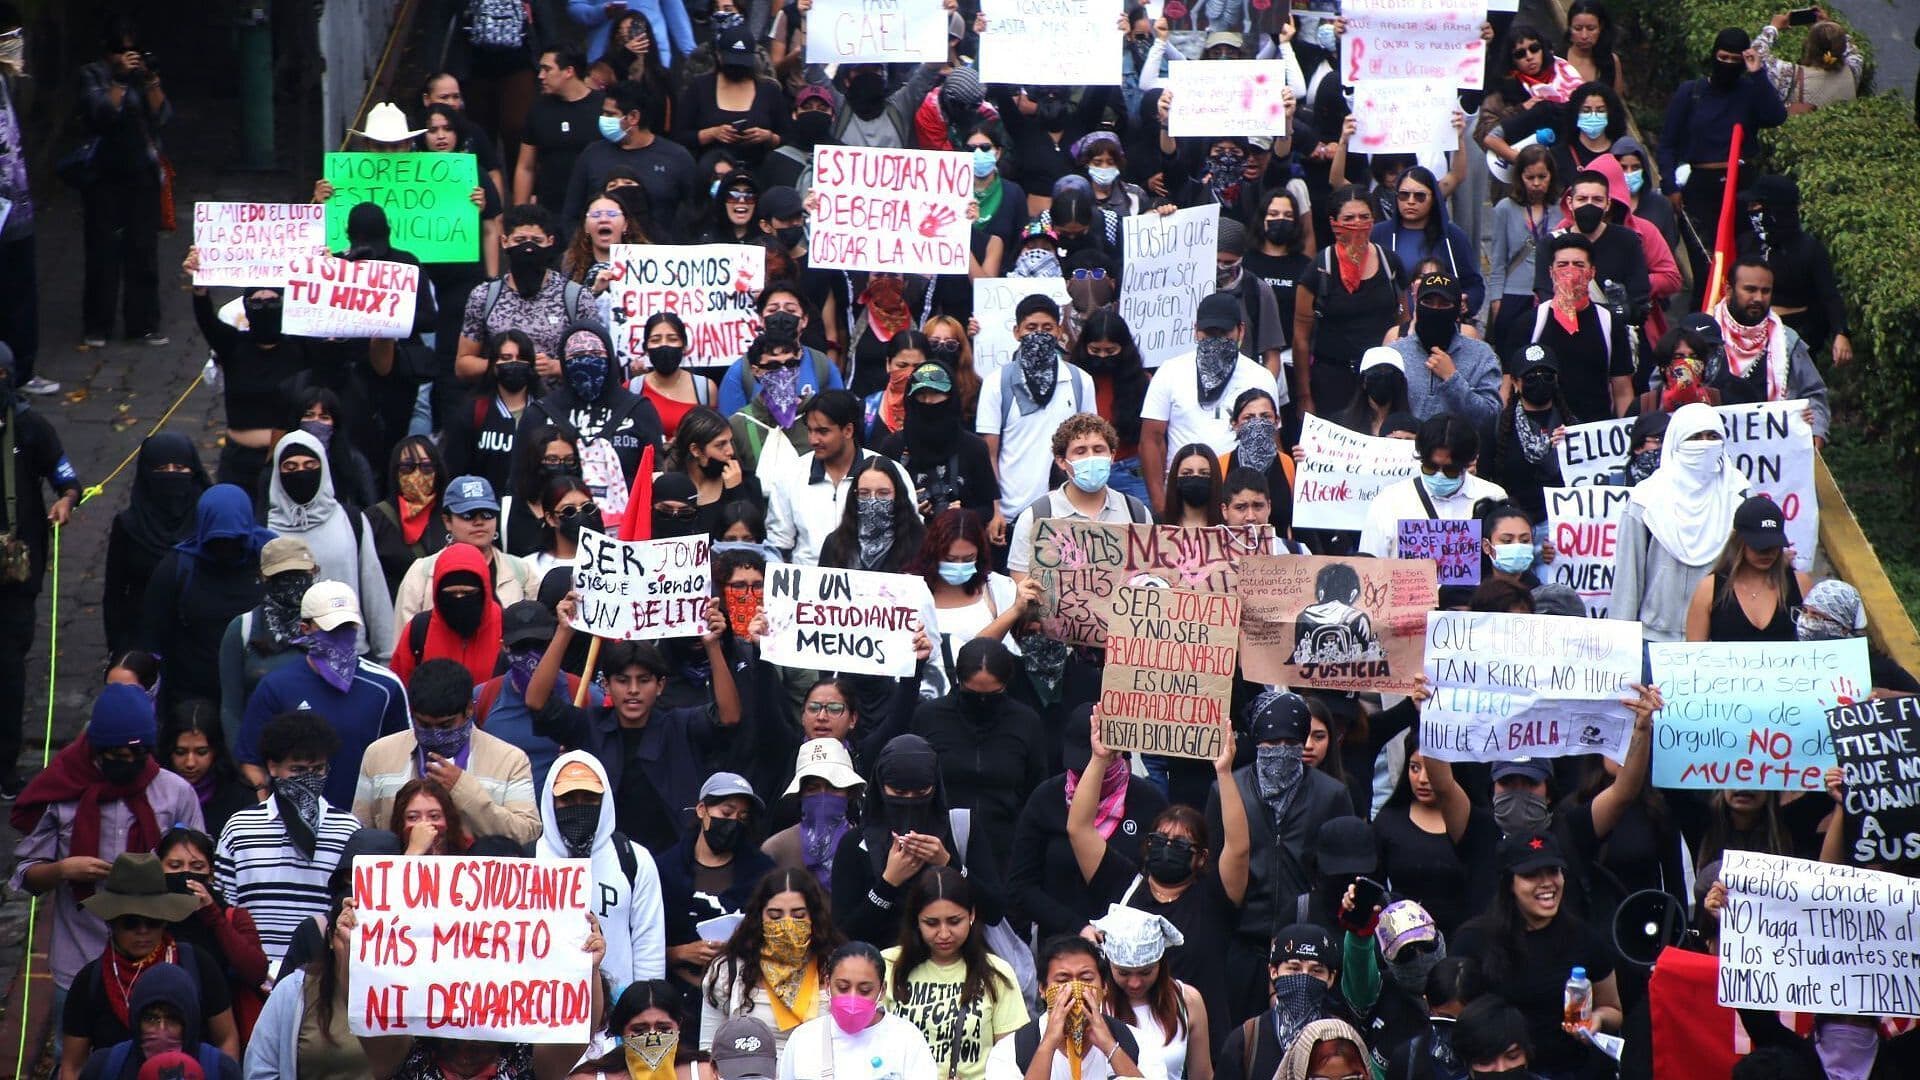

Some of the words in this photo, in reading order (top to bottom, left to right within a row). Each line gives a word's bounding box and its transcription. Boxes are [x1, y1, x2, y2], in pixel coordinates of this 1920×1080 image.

[835, 12, 922, 56] GAEL
[817, 150, 928, 193] ESTUDIAR
[937, 157, 971, 198] NO
[197, 204, 213, 223] EL
[219, 204, 266, 223] MIEDO
[269, 205, 286, 222] EL
[288, 204, 323, 220] LUTO
[333, 187, 436, 210] ESTADO
[816, 193, 913, 232] DEBERIA
[196, 226, 203, 242] Y
[209, 226, 227, 243] LA
[231, 221, 309, 246] SANGRE
[812, 230, 868, 265] COSTAR
[877, 237, 904, 265] LA
[912, 241, 966, 268] VIDA
[1127, 215, 1178, 259] Hasta
[200, 246, 220, 262] NO
[224, 246, 255, 262] SON
[352, 259, 417, 293] FUERA
[625, 259, 658, 286] NO
[661, 257, 731, 288] SOMOS
[1122, 262, 1169, 294] Querer
[1172, 260, 1199, 288] ser
[1425, 275, 1452, 287] CAT
[288, 279, 321, 305] TU
[329, 285, 401, 318] HIJX?
[622, 289, 704, 318] CIFRAS
[707, 289, 758, 312] SOMOS
[1147, 329, 1165, 350] un
[1399, 535, 1418, 546] NO
[1420, 535, 1438, 548] SE
[1404, 521, 1423, 535] LA
[1425, 519, 1471, 535] LUCHA
[580, 532, 645, 577] SER
[652, 540, 711, 573] JOVEN
[1241, 561, 1257, 577] Por
[647, 574, 705, 595] siendo
[771, 567, 802, 601] NI
[819, 572, 852, 602] UN
[581, 595, 620, 629] UN
[631, 595, 712, 632] DELITO
[796, 602, 919, 633] ESTUDIANTE
[1112, 586, 1161, 618] SER
[1167, 591, 1239, 628] JOVEN
[796, 628, 885, 664] MENOS
[1129, 617, 1144, 638] Y
[1145, 619, 1171, 641] NO
[1174, 621, 1209, 645] SER
[1432, 616, 1480, 652] QUE
[1490, 615, 1613, 662] LIBERTAD
[1105, 635, 1235, 677] REVOLUCIONARIO
[1299, 660, 1391, 679] JUSTICIA
[1133, 669, 1157, 692] ES
[1160, 672, 1198, 695] UNA
[1431, 657, 1477, 684] TAN
[1550, 665, 1576, 693] NO
[1584, 667, 1632, 694] HUELE
[1774, 677, 1824, 693] ser
[1101, 689, 1222, 726] CONTRADICCIÓN
[1427, 687, 1442, 711] A
[1452, 689, 1512, 717] LIBRO
[1659, 699, 1754, 725] motivo
[1768, 701, 1802, 727] de
[1827, 698, 1893, 730] ¿QUÉ
[1100, 719, 1138, 749] HASTA
[1142, 723, 1222, 758] BIOLOGICA
[1424, 720, 1479, 753] HUELE
[1483, 725, 1500, 753] A
[1508, 720, 1560, 751] BALA
[1658, 723, 1738, 753] Orgullo
[1748, 727, 1792, 761] NO
[1801, 728, 1836, 757] de
[1835, 727, 1917, 757] TIENE
[1861, 815, 1887, 839] A
[354, 860, 394, 912] NI
[402, 860, 441, 909] UN
[598, 881, 618, 918] P
[1724, 871, 1799, 902] pueblos
[1811, 876, 1879, 904] donde
[1887, 884, 1904, 907] la
[1723, 899, 1753, 935] NO
[1758, 903, 1799, 948] haga
[1801, 908, 1888, 943] TEMBLAR
[1895, 909, 1914, 942] al
[359, 915, 418, 967] MÁS
[431, 918, 551, 964] MUERTO
[1741, 936, 1762, 965] los
[1772, 938, 1887, 967] estudiantes
[365, 984, 409, 1031] NI
[426, 978, 591, 1030] DESAPARECIDO
[1786, 975, 1823, 1008] ante
[1830, 975, 1847, 1007] el
